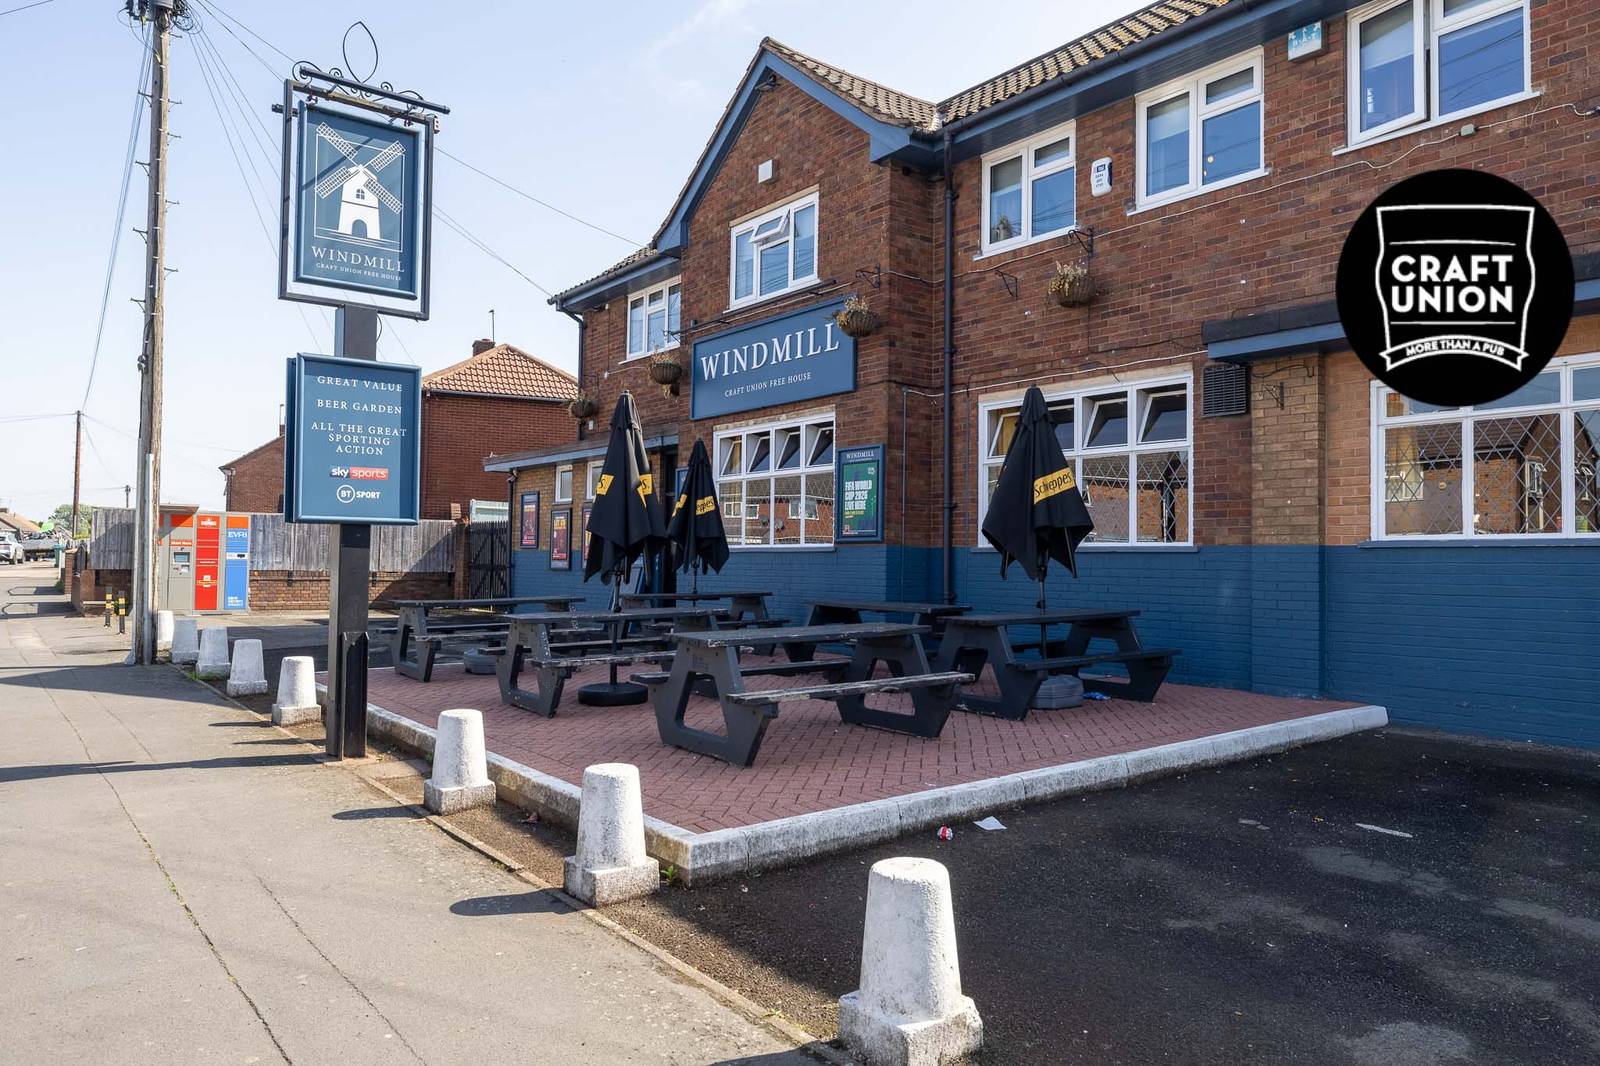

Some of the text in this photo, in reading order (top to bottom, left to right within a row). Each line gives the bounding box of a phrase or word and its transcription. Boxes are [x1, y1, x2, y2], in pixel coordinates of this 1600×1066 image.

[311, 246, 405, 272] WINDMILL
[316, 262, 338, 271] CRAFT
[340, 266, 362, 275] UNION
[364, 270, 379, 278] FREE
[700, 322, 840, 381] WINDMILL
[317, 375, 403, 392] GREAT VALUE
[724, 371, 812, 398] CRAFT UNION FREE HOUSE
[317, 399, 402, 415] BEER GARDEN
[311, 421, 407, 437] ALL THE GREAT
[328, 433, 390, 446] SPORTING
[336, 444, 383, 456] ACTION
[846, 450, 875, 460] WINDMILL
[331, 466, 387, 479] sky sports
[356, 491, 381, 499] SPORT
